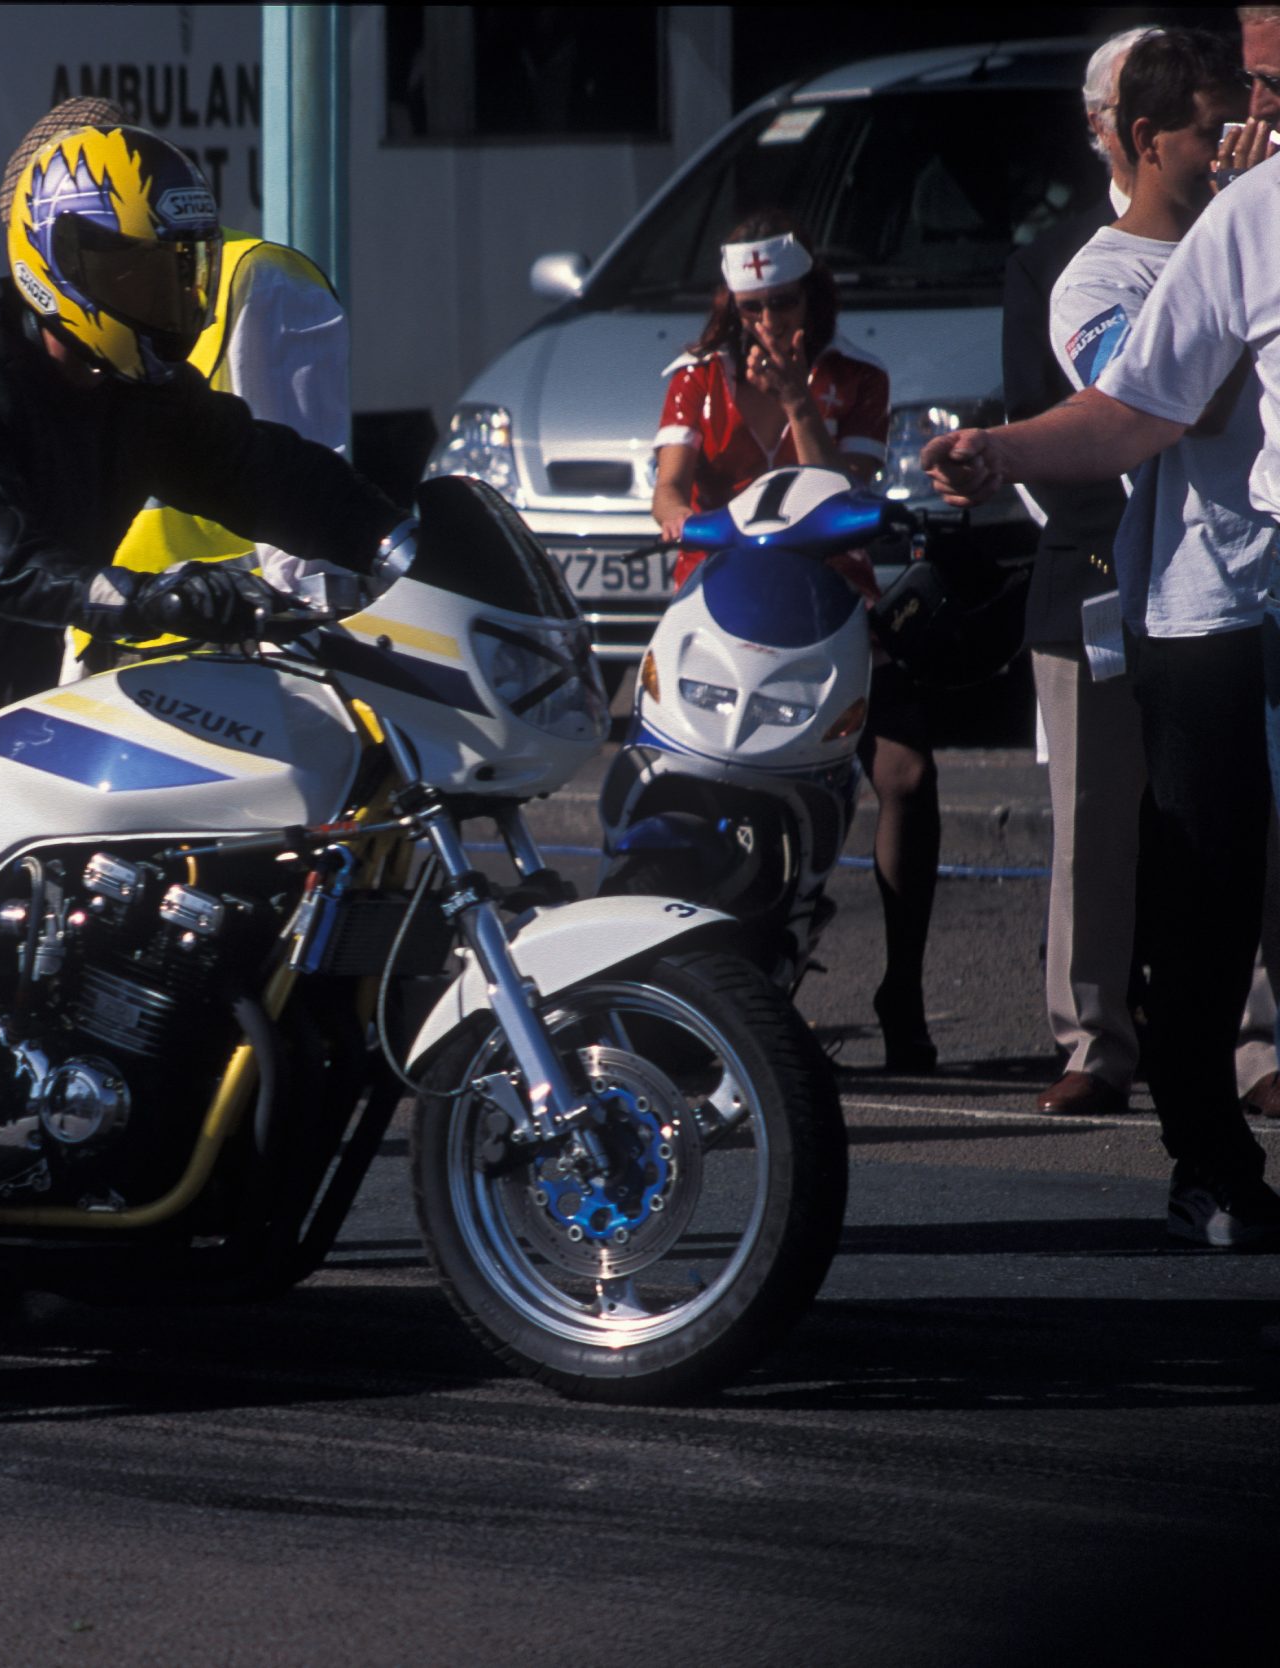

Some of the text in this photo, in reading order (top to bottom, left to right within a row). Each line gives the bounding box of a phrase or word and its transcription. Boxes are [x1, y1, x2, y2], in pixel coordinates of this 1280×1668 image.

[170, 194, 214, 215] SHOE
[743, 469, 802, 529] 1
[135, 688, 265, 748] SUZUKI
